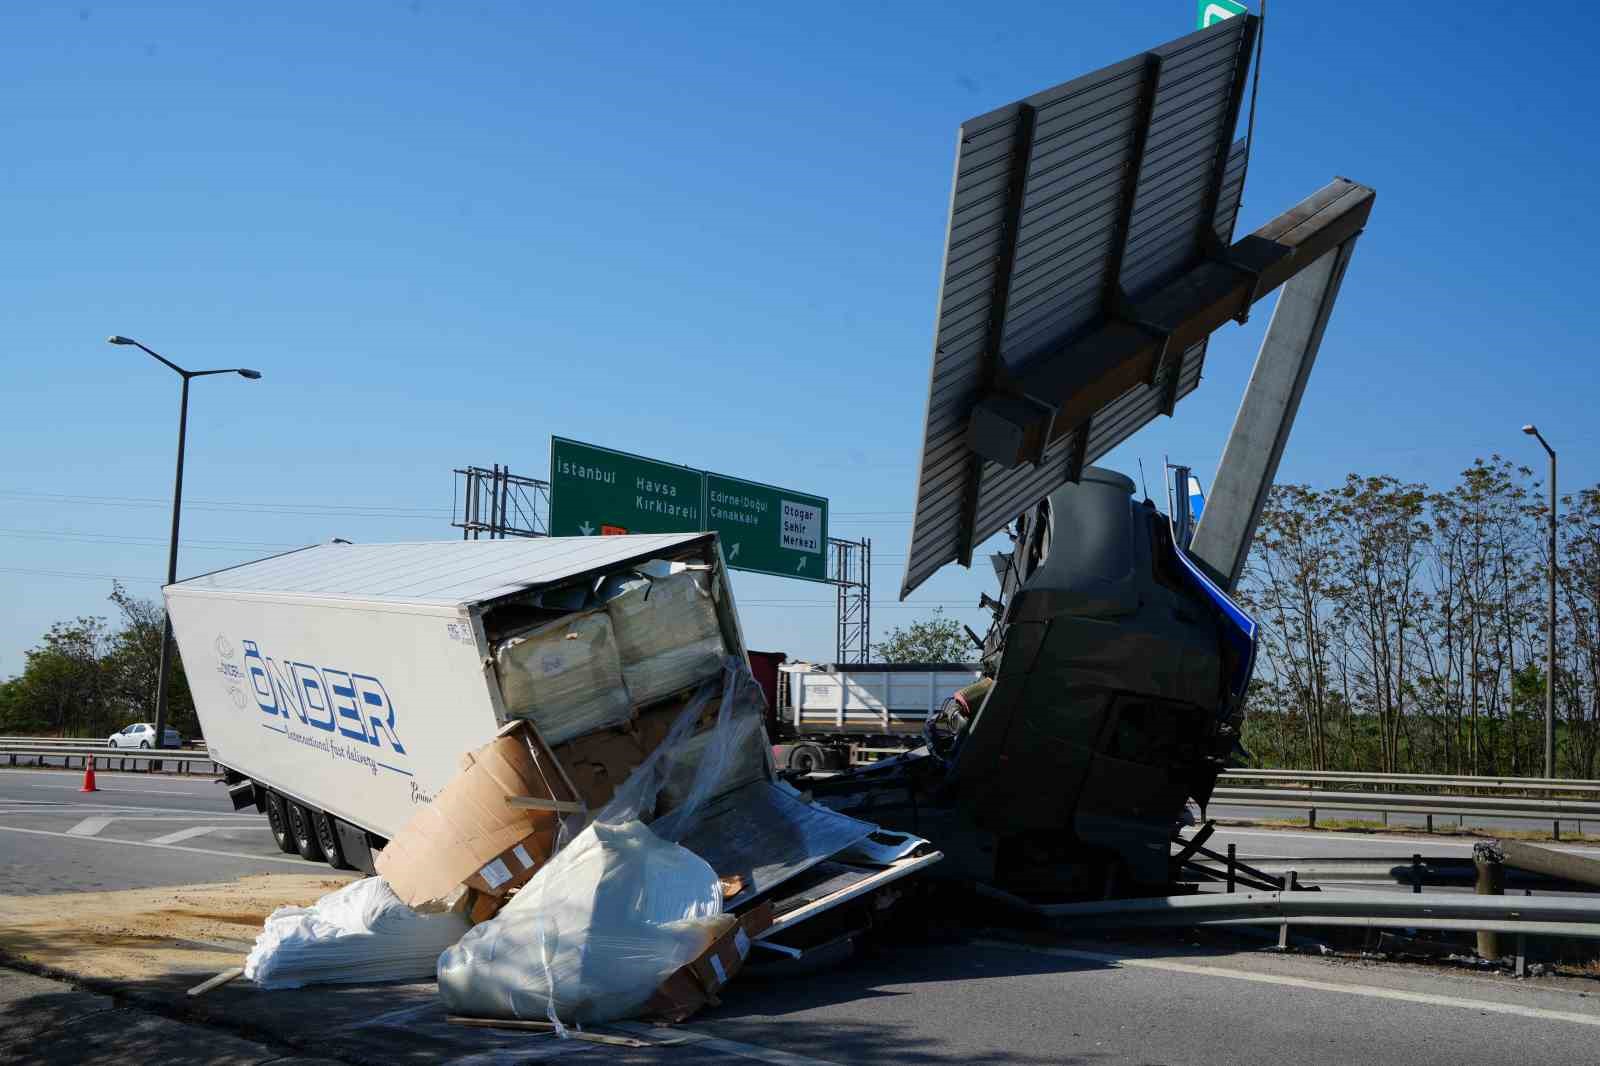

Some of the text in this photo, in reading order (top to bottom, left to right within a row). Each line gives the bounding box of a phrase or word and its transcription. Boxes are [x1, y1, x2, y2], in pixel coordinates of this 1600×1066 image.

[557, 456, 616, 484] İstanbul
[636, 475, 678, 497] Havsa
[784, 505, 814, 521] Otogar
[783, 534, 817, 549] Merkezi
[242, 639, 407, 755] ÖNDER
[329, 737, 345, 760] fast
[346, 744, 378, 776] delivery
